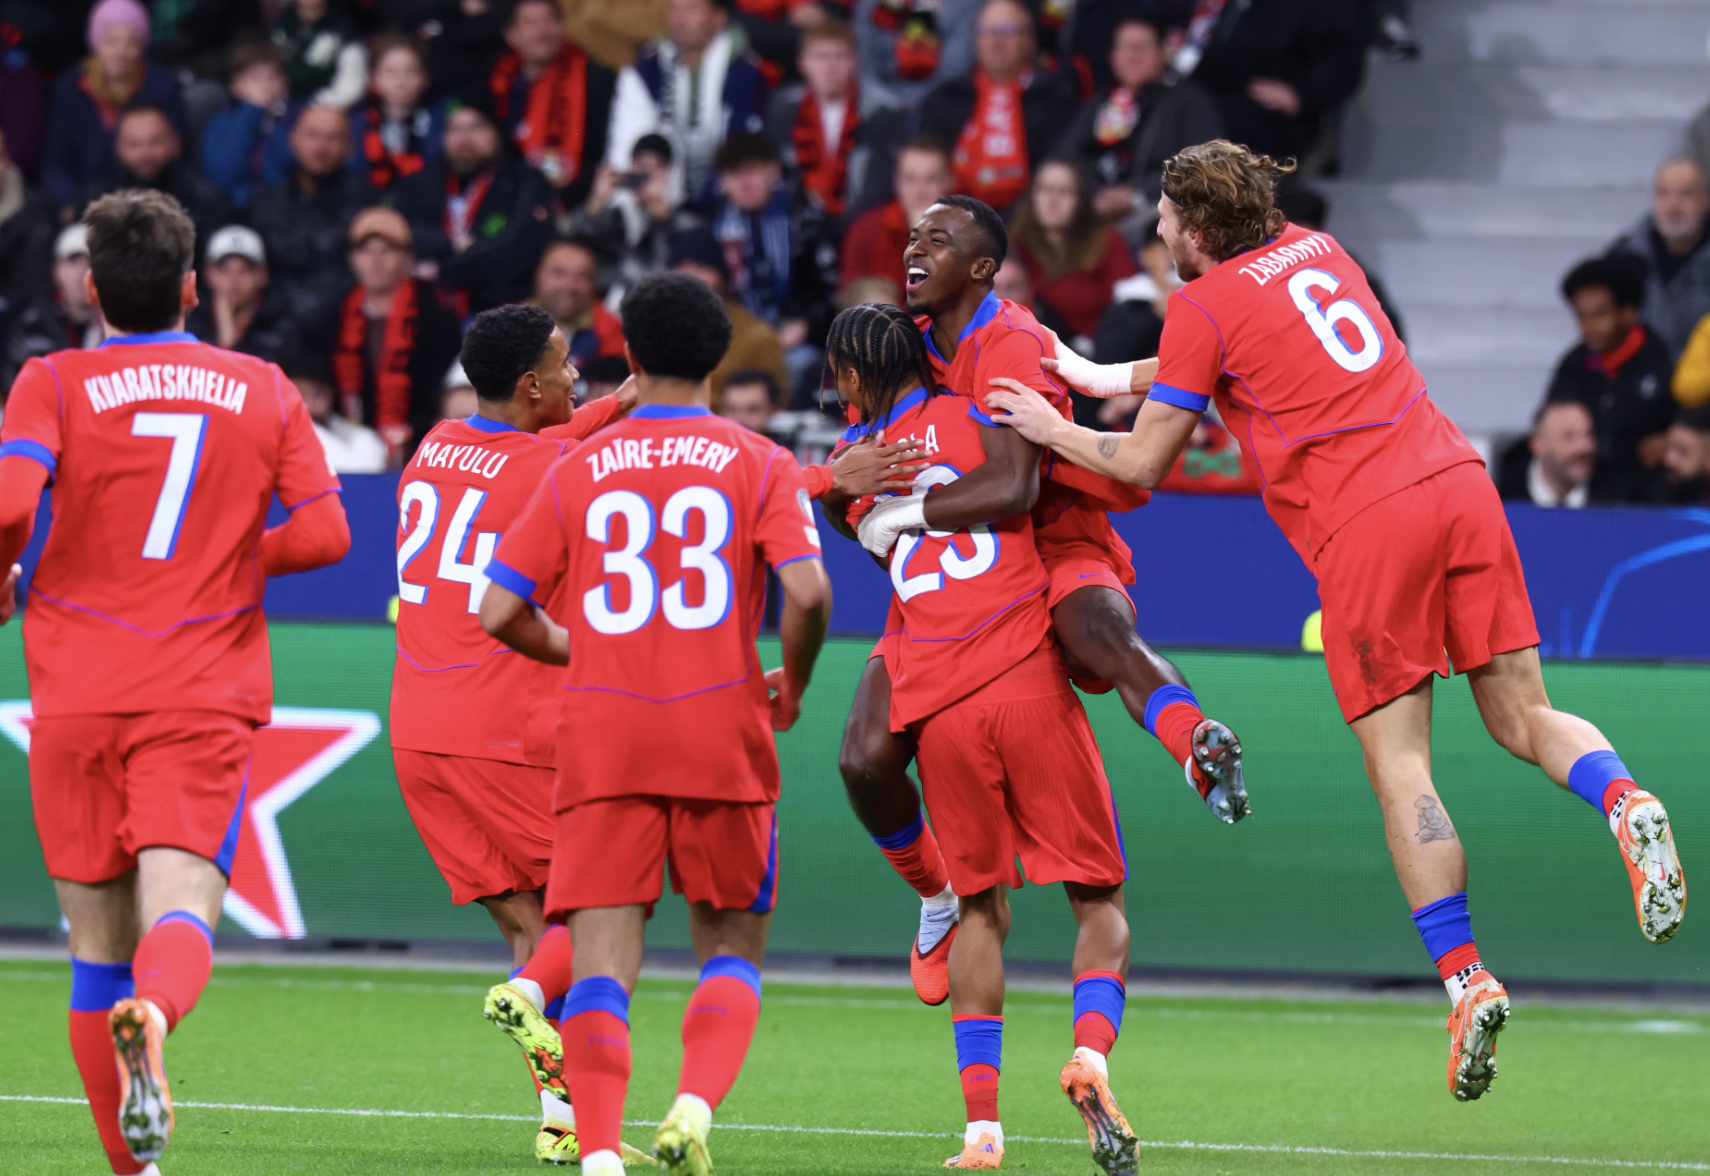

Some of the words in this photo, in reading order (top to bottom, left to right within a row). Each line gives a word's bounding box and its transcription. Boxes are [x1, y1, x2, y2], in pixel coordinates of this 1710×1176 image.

[1238, 235, 1331, 286] ZABARNYI
[1287, 267, 1384, 373] 6
[85, 364, 248, 415] KVARATSKHELIA
[131, 412, 210, 560] 7
[416, 442, 509, 479] MAYULU
[586, 436, 738, 483] ZAÏRE-EMERY
[397, 480, 501, 615] 24
[583, 485, 735, 635] 33
